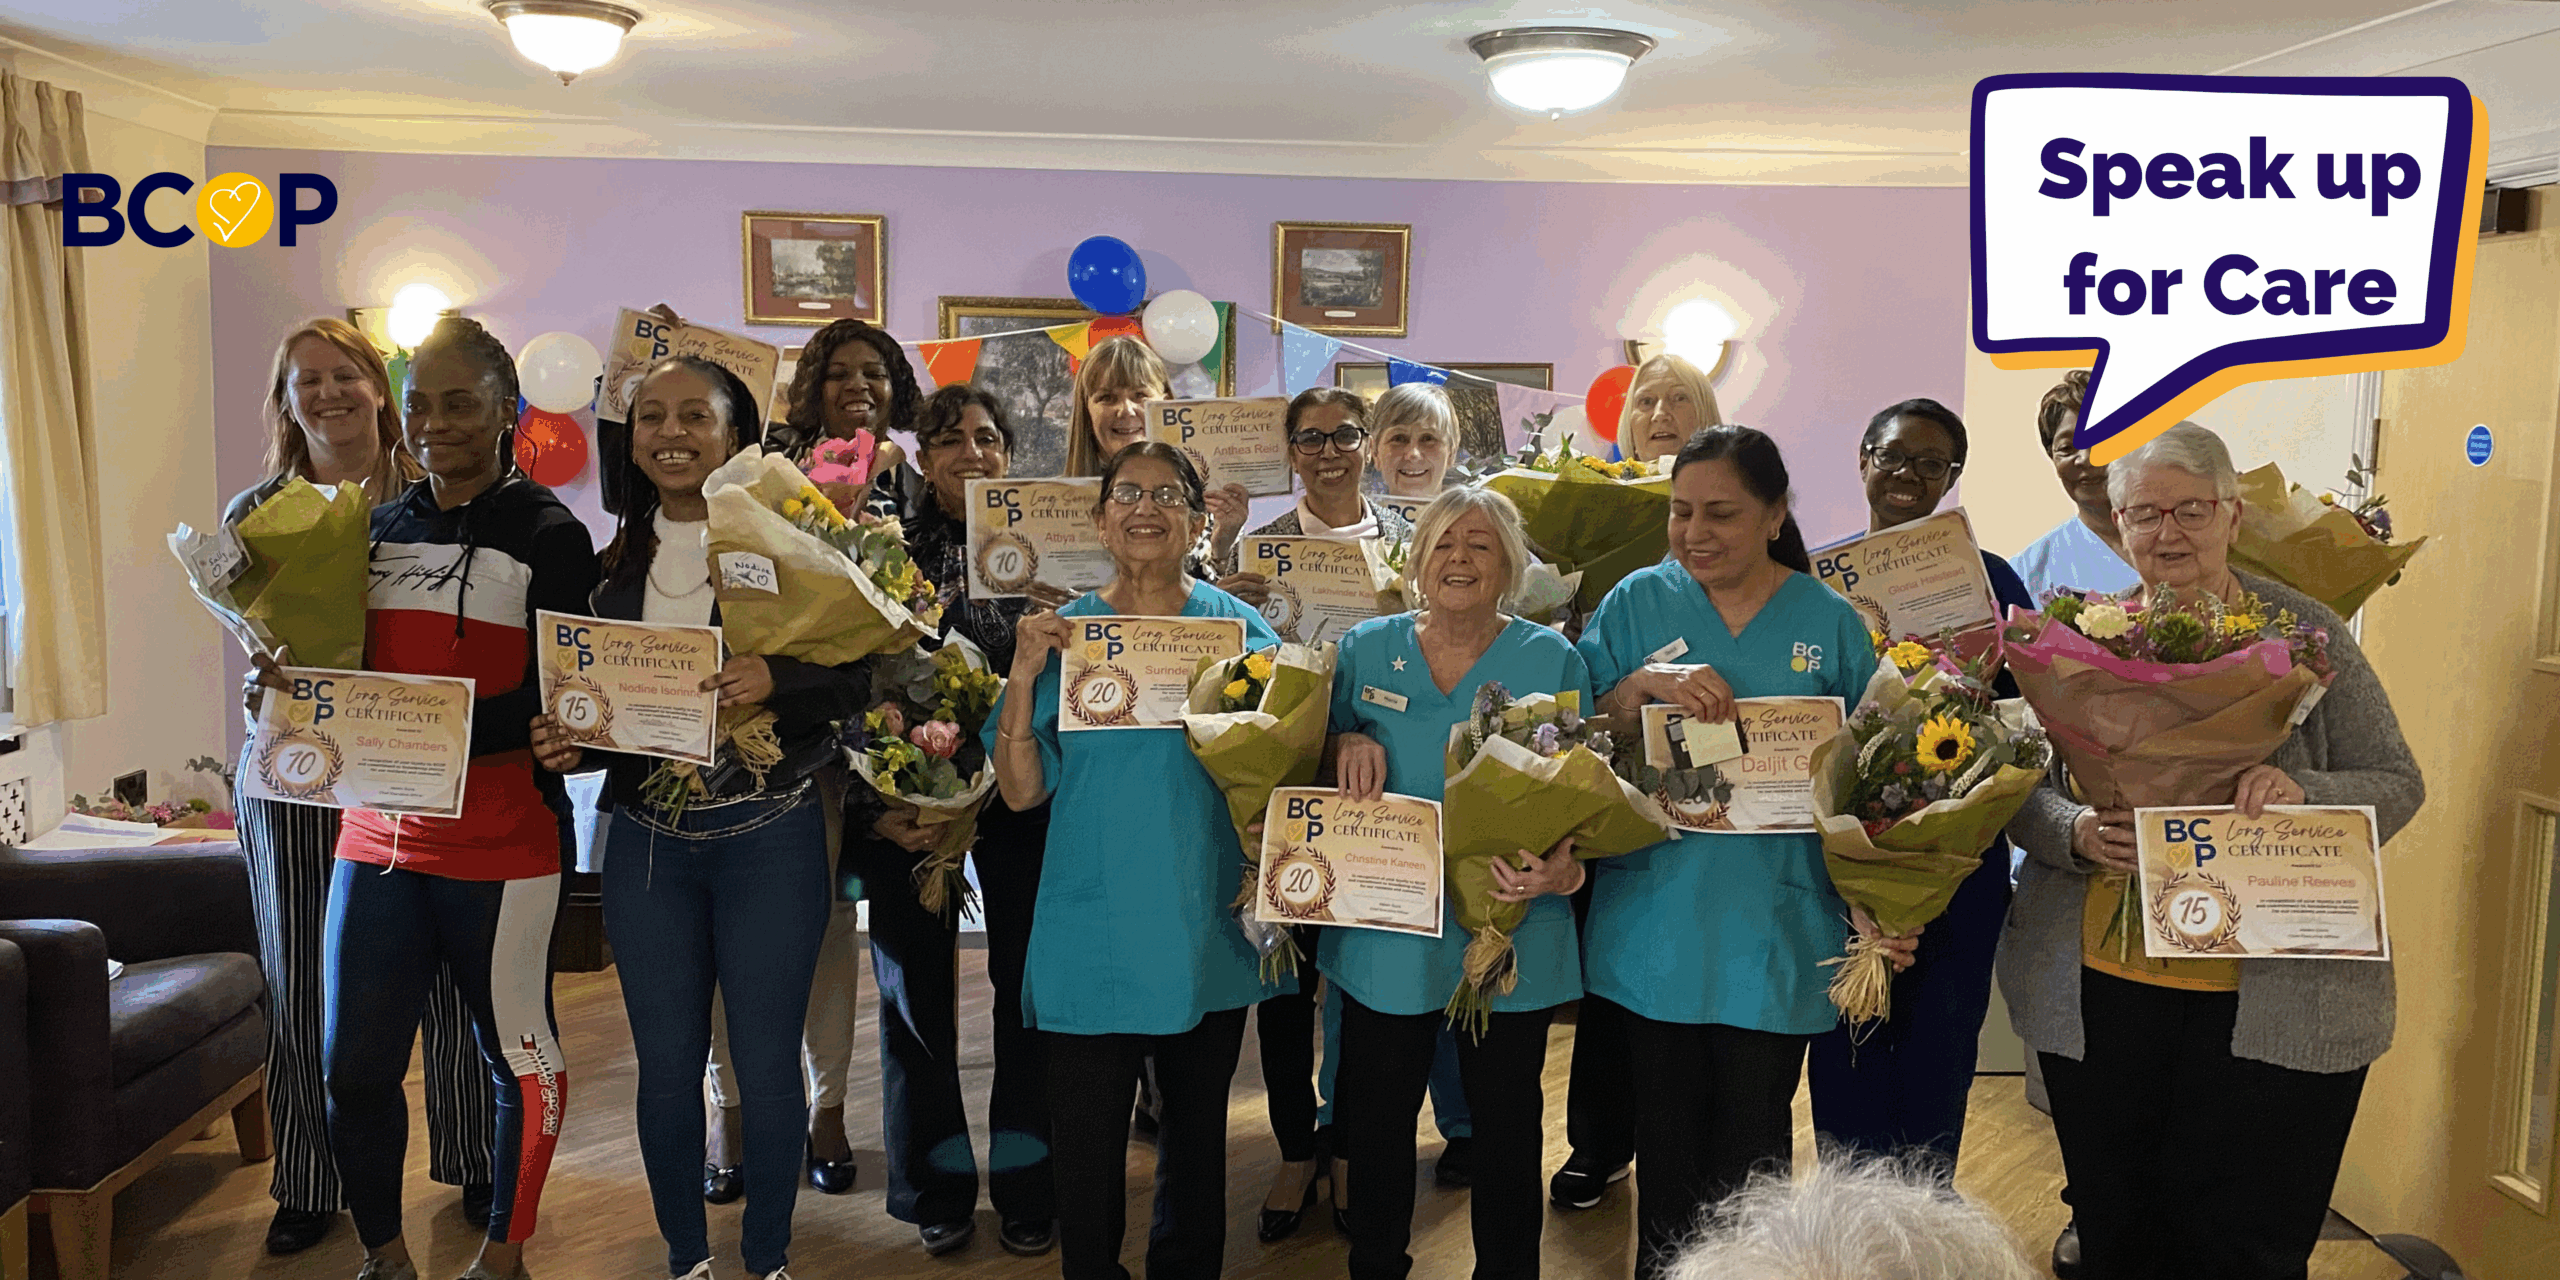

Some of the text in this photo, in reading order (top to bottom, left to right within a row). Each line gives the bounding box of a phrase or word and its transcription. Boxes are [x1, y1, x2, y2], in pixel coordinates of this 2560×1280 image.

[678, 332, 764, 363] Long Service
[1201, 405, 1275, 428] Long Service
[1202, 423, 1272, 435] CERTIFICATE
[1213, 443, 1279, 456] Anthea Reid
[1030, 489, 1057, 509] Long
[1300, 545, 1326, 565] Long
[1863, 528, 1951, 569] Long Service
[995, 551, 1018, 573] 10
[1867, 544, 1952, 576] CERTIFICATE
[1888, 580, 1919, 596] Gloria
[1920, 566, 1966, 586] Halstead
[602, 632, 700, 658] Long Service
[1133, 625, 1227, 648] Long Service
[1133, 642, 1220, 655] CERTIFICATE
[603, 654, 695, 671] CERTIFICATE
[1145, 665, 1189, 676] Surinde
[345, 684, 449, 711] Long Service
[618, 682, 658, 695] Nodine
[1088, 682, 1117, 704] 20
[345, 707, 442, 724] CERTIFICATE
[565, 697, 589, 721] 15
[1759, 709, 1823, 729] Service
[356, 736, 448, 752] Sally Chambers
[286, 751, 316, 775] 10
[1741, 754, 1787, 776] Daljit
[1333, 802, 1426, 827] Long Service
[1333, 825, 1420, 843] CERTIFICATE
[2226, 819, 2348, 846] Long Service
[1345, 852, 1426, 870] Christine Kaneen
[2228, 845, 2343, 858] CERTIFICATE
[1285, 868, 1314, 893] 20
[2247, 875, 2357, 888] Pauline Reeves
[2178, 897, 2210, 925] 15
